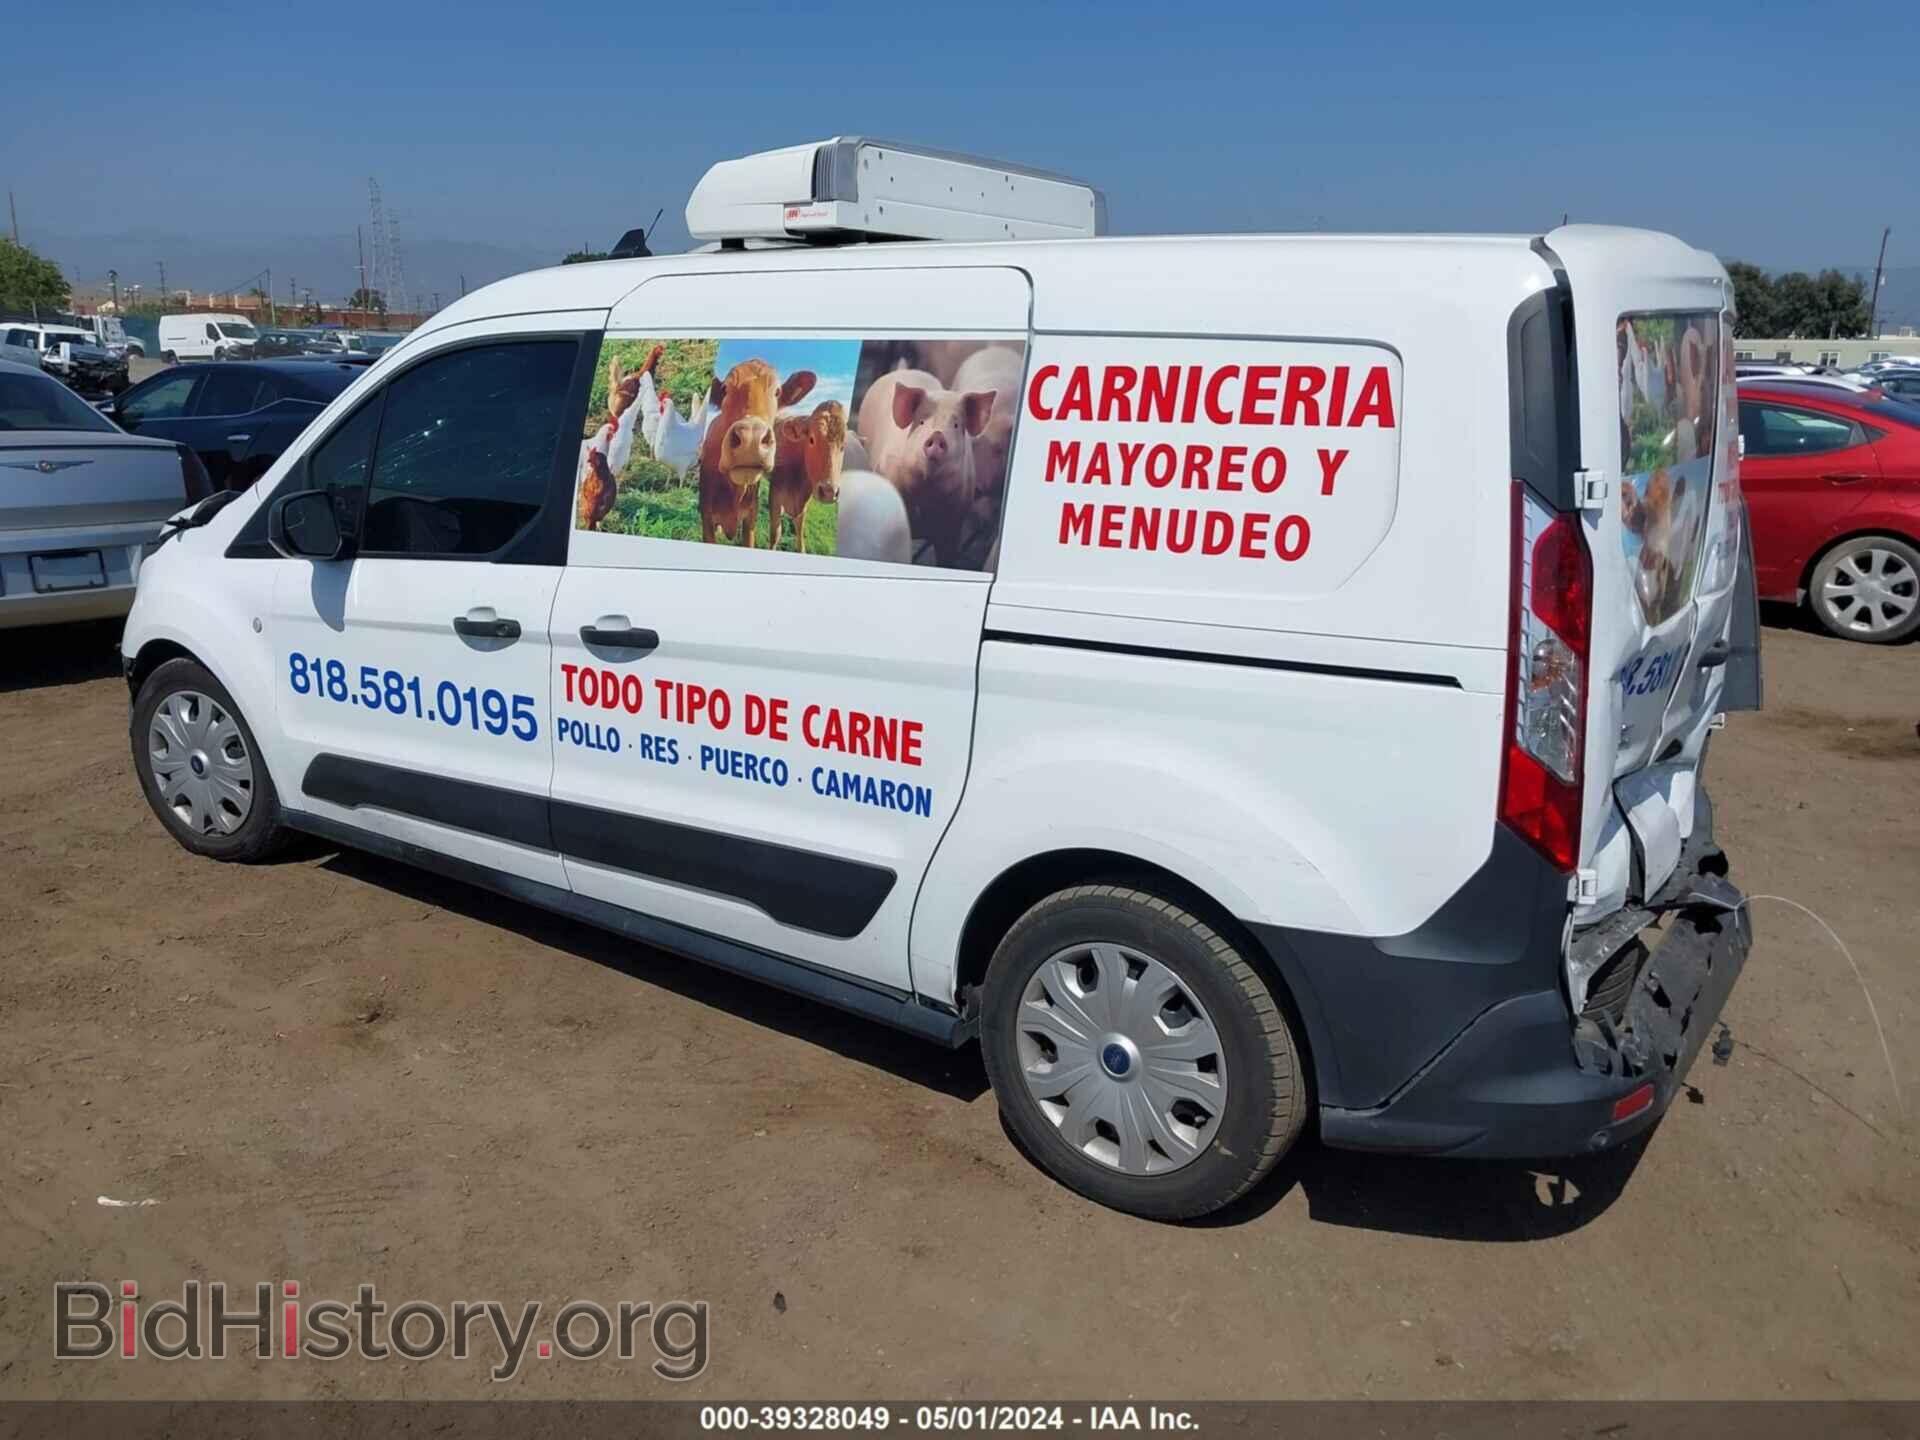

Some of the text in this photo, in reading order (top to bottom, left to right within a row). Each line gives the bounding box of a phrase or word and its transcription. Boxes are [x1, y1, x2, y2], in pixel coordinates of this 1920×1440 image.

[1028, 364, 1395, 428] CARNICERIA
[1045, 440, 1348, 496] MAYOREO Y
[1059, 502, 1311, 561] MENUDEO
[288, 651, 539, 743] 818.581.0195
[561, 664, 924, 766] TODO TIPO DE CARNE
[557, 716, 933, 816] POLLO RES PUERCO CAMARON
